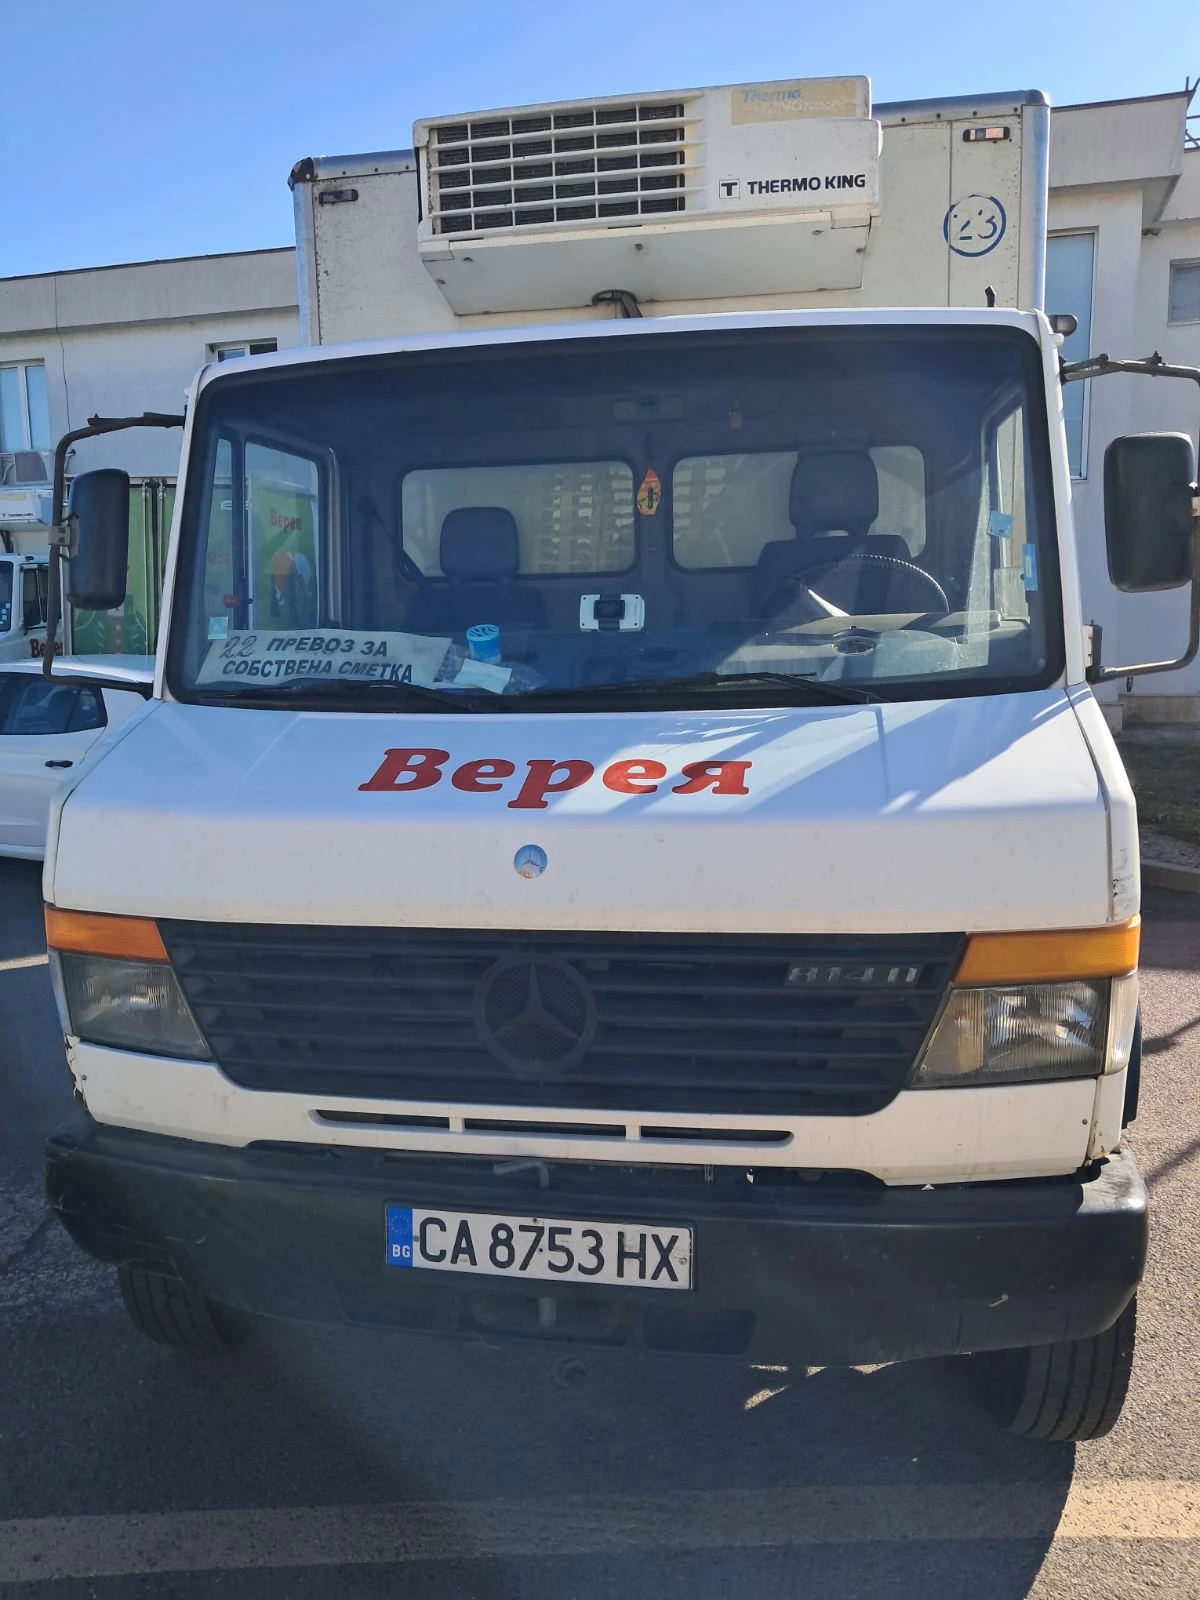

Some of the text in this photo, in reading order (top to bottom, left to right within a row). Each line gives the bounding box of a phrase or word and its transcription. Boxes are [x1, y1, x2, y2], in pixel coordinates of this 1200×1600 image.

[747, 176, 821, 195] THERMO
[824, 174, 866, 190] KING
[265, 637, 355, 653] ПРЕВОЗ
[360, 640, 388, 657] ЗА
[222, 659, 412, 683] СОБСТВЕНА СМЕТКА
[357, 747, 754, 809] Верея
[391, 1243, 411, 1259] BG
[418, 1216, 680, 1283] CA 8753 HX
